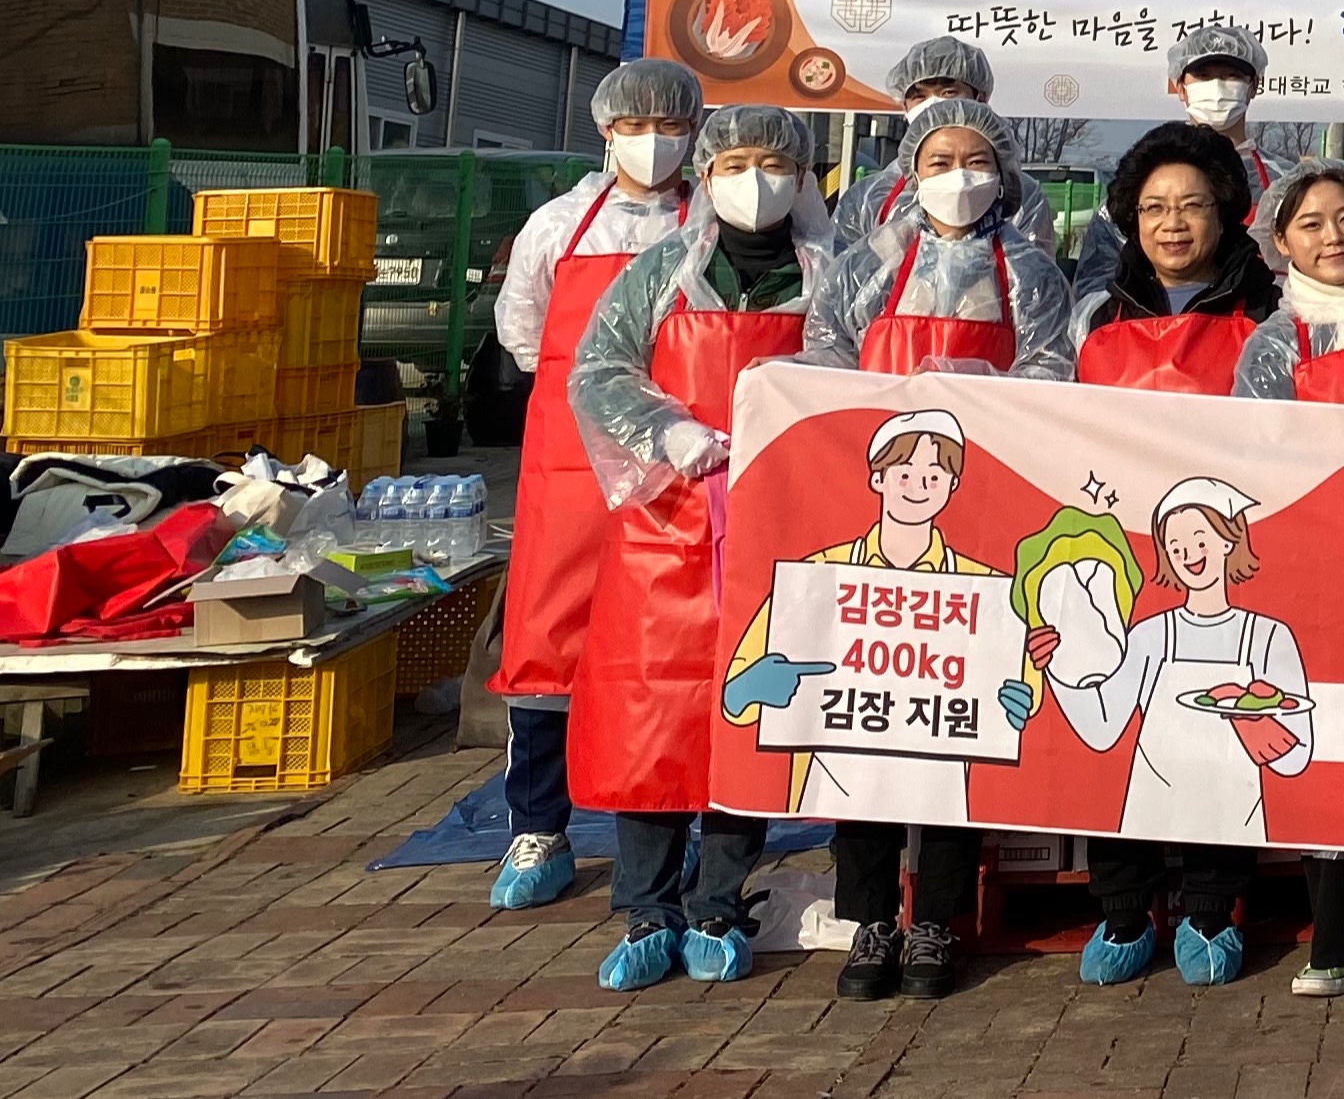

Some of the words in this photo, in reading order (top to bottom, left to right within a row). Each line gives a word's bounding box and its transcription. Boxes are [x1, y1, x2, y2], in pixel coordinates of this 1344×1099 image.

[946, 5, 1057, 44] 따뜻한
[1072, 7, 1160, 52] 마음을
[1171, 9, 1315, 46] 전다!
[836, 582, 980, 635] 김장김치
[841, 637, 966, 689] 400kg
[819, 687, 896, 733] 김장
[905, 694, 980, 739] 지원
